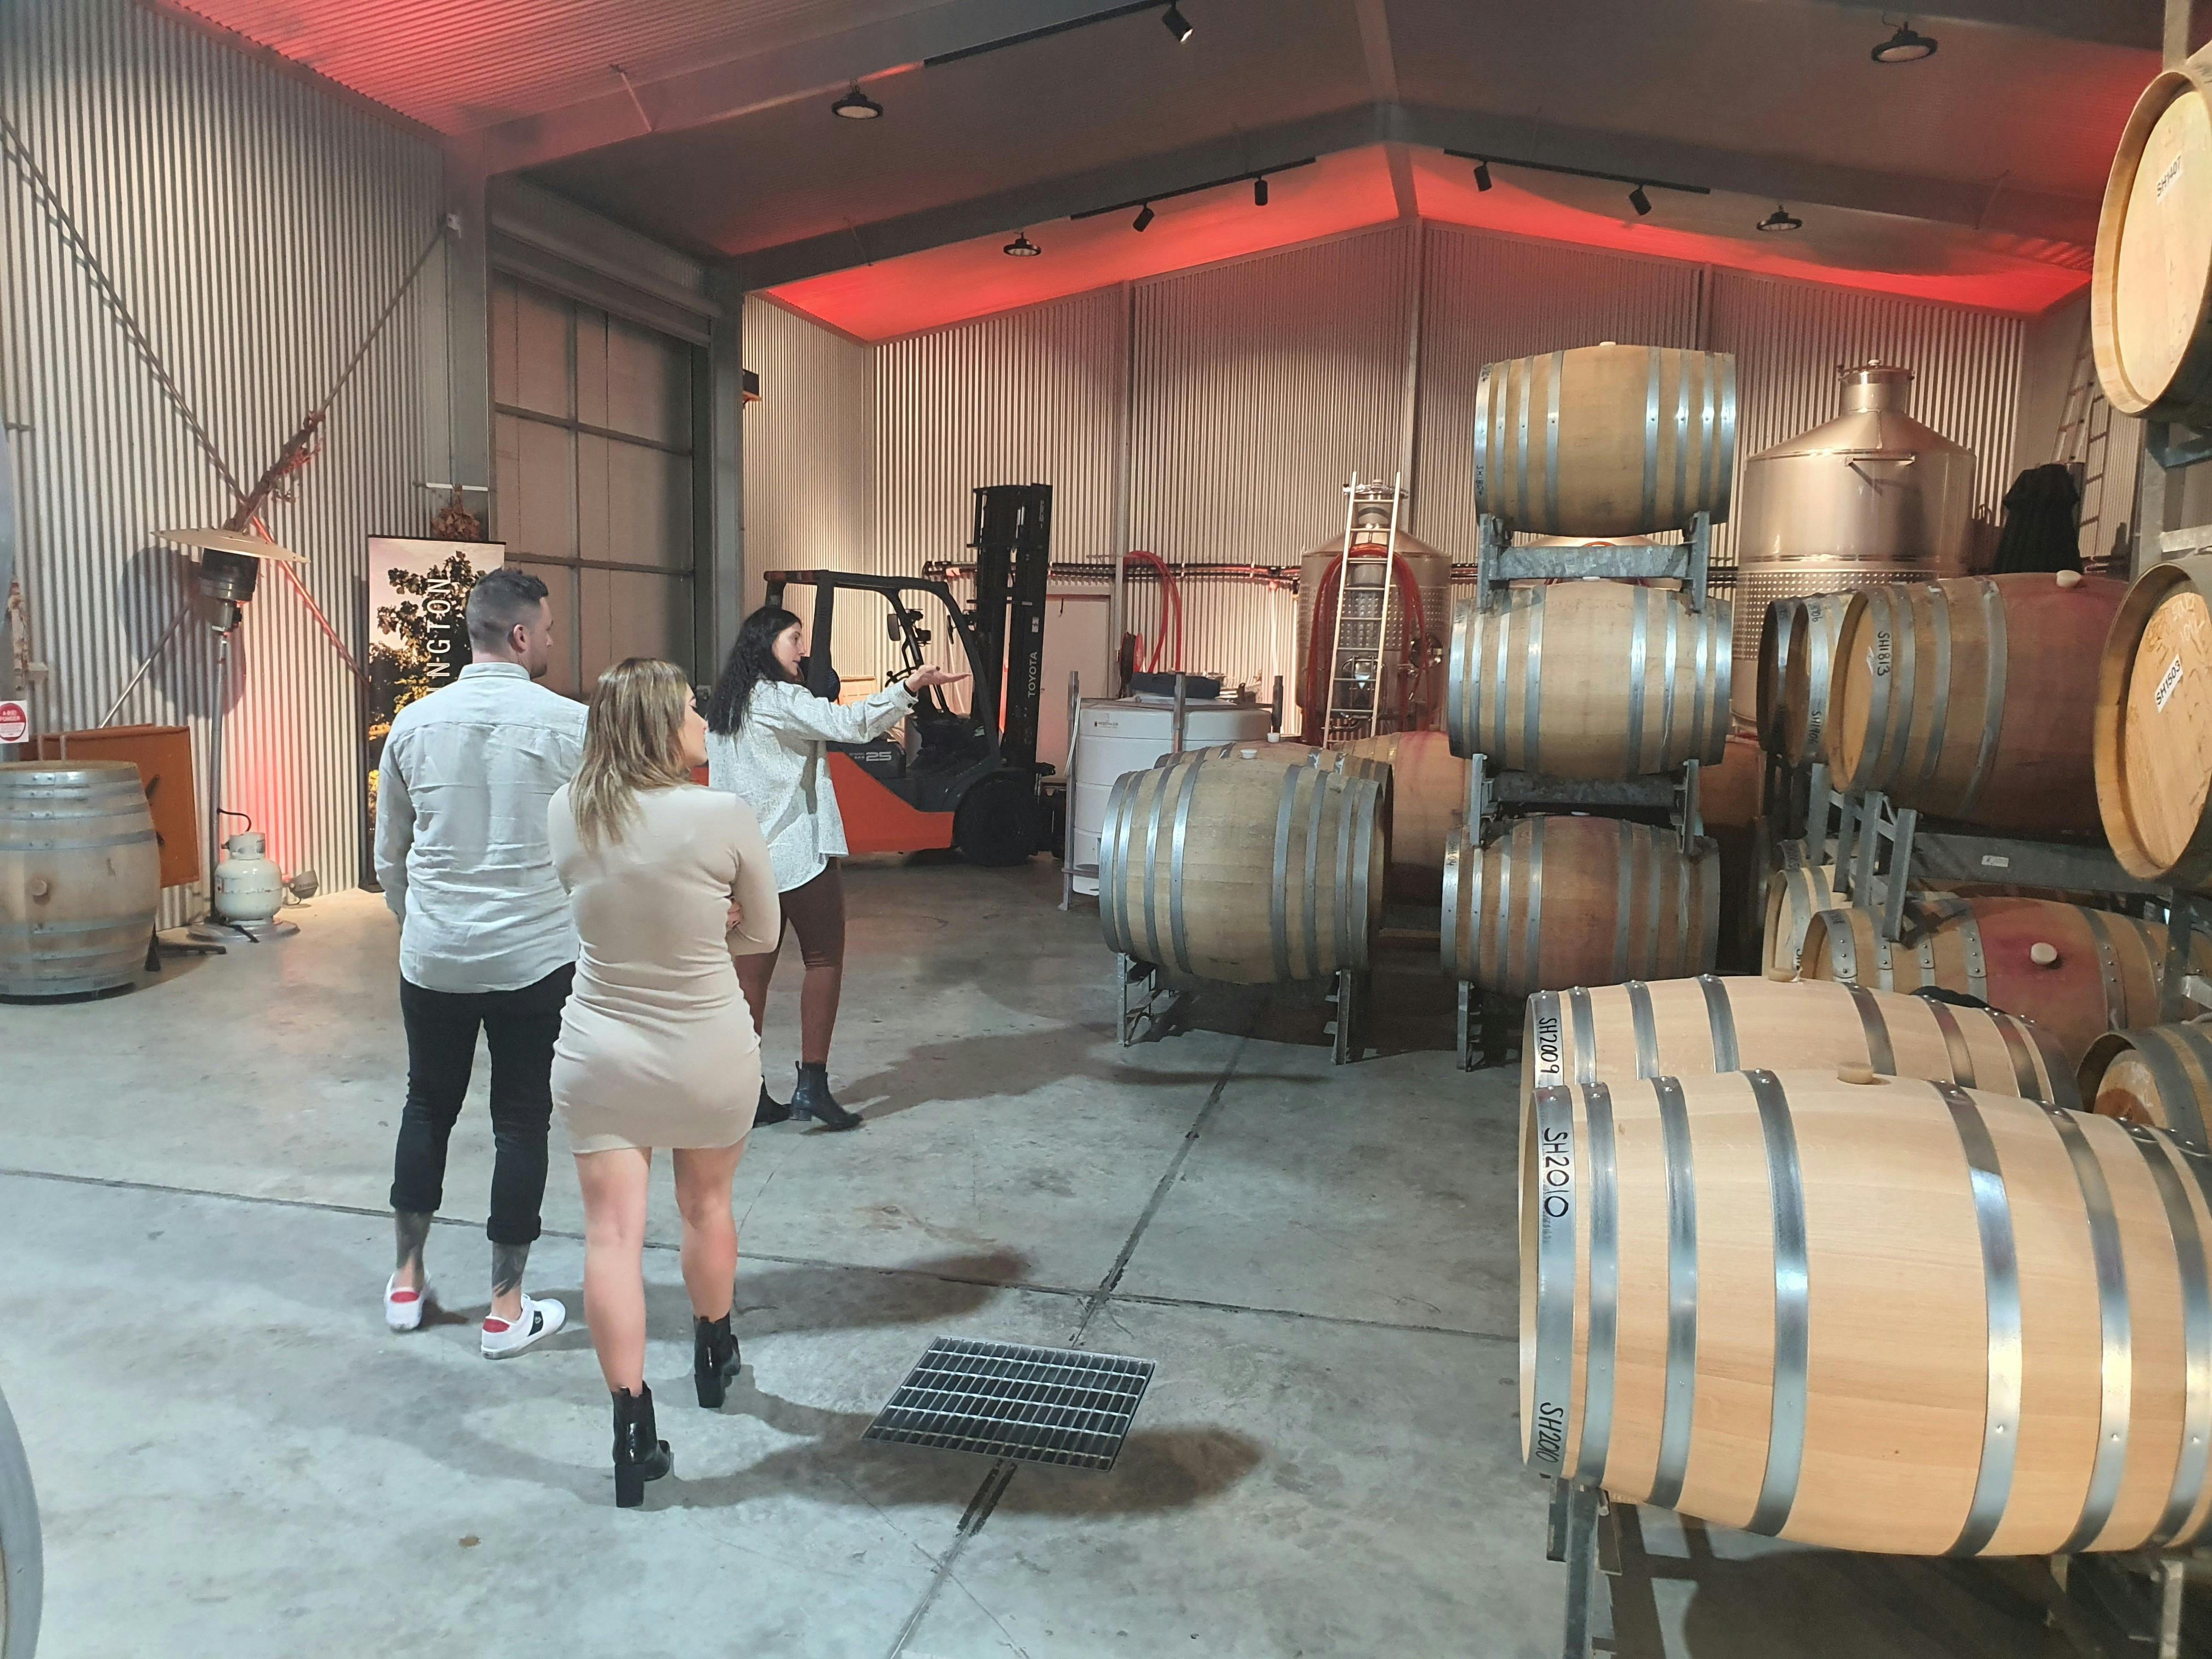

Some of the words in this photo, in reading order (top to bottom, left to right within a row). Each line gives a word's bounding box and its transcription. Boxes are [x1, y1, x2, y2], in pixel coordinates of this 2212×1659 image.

[2157, 155, 2181, 198] SH1407
[1028, 651, 1038, 698] TOYOTA
[1877, 631, 1891, 676] SH1813
[2156, 659, 2181, 705] SH1503
[866, 751, 891, 761] 25
[1539, 1017, 1560, 1074] SH2009
[1543, 1127, 1570, 1218] SH2010
[1535, 1402, 1564, 1463] SH2010
